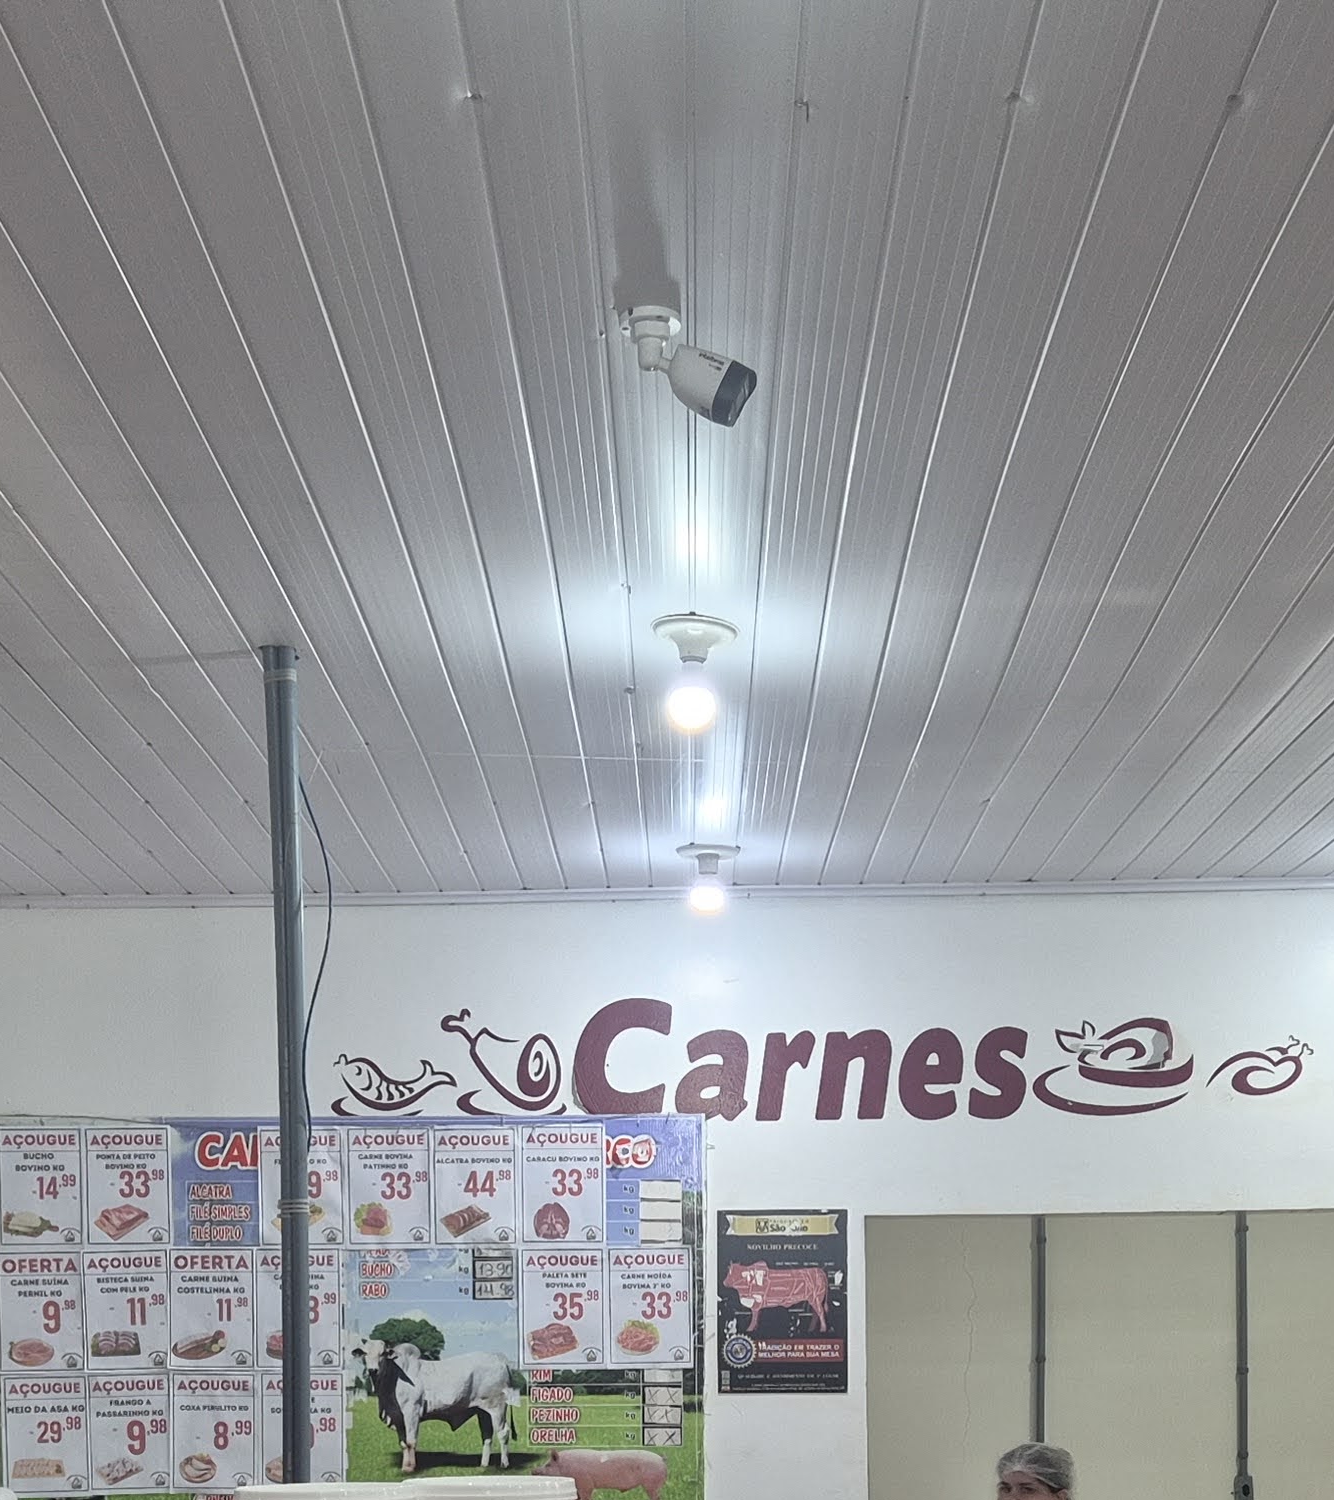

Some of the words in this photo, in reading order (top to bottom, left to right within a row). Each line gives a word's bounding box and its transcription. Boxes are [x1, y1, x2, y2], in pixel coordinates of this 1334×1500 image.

[573, 997, 1027, 1122] Carnes
[1, 1134, 76, 1149] AÇOUGUE
[90, 1134, 163, 1150] AÇOUGUE
[352, 1134, 425, 1150] AÇOUGUE
[438, 1135, 509, 1150] AÇOUGUE
[526, 1132, 597, 1148] AÇOUGUE
[23, 1152, 55, 1160] BUCHO
[189, 1185, 232, 1199] ALCATRA
[190, 1203, 210, 1221] FILÉ
[211, 1206, 250, 1221] SIMPLES
[190, 1223, 210, 1241] FILÉ
[211, 1226, 243, 1241] DUPLO
[1, 1257, 78, 1274] OFERTA
[87, 1257, 162, 1273] AÇOUGUE
[173, 1255, 249, 1271] OFERTA
[526, 1255, 598, 1269] AÇOUGUE
[613, 1254, 685, 1268] AÇOUGUE
[361, 1263, 394, 1277] BUCHO
[361, 1284, 388, 1297] RABO
[9, 1382, 81, 1398] AÇOUGUE
[92, 1379, 164, 1395] AÇOUGUE
[177, 1379, 249, 1395] AÇOUGUE
[531, 1388, 573, 1402] FIGADO
[531, 1409, 579, 1422] PEZINHO
[531, 1430, 576, 1442] ORELHA
